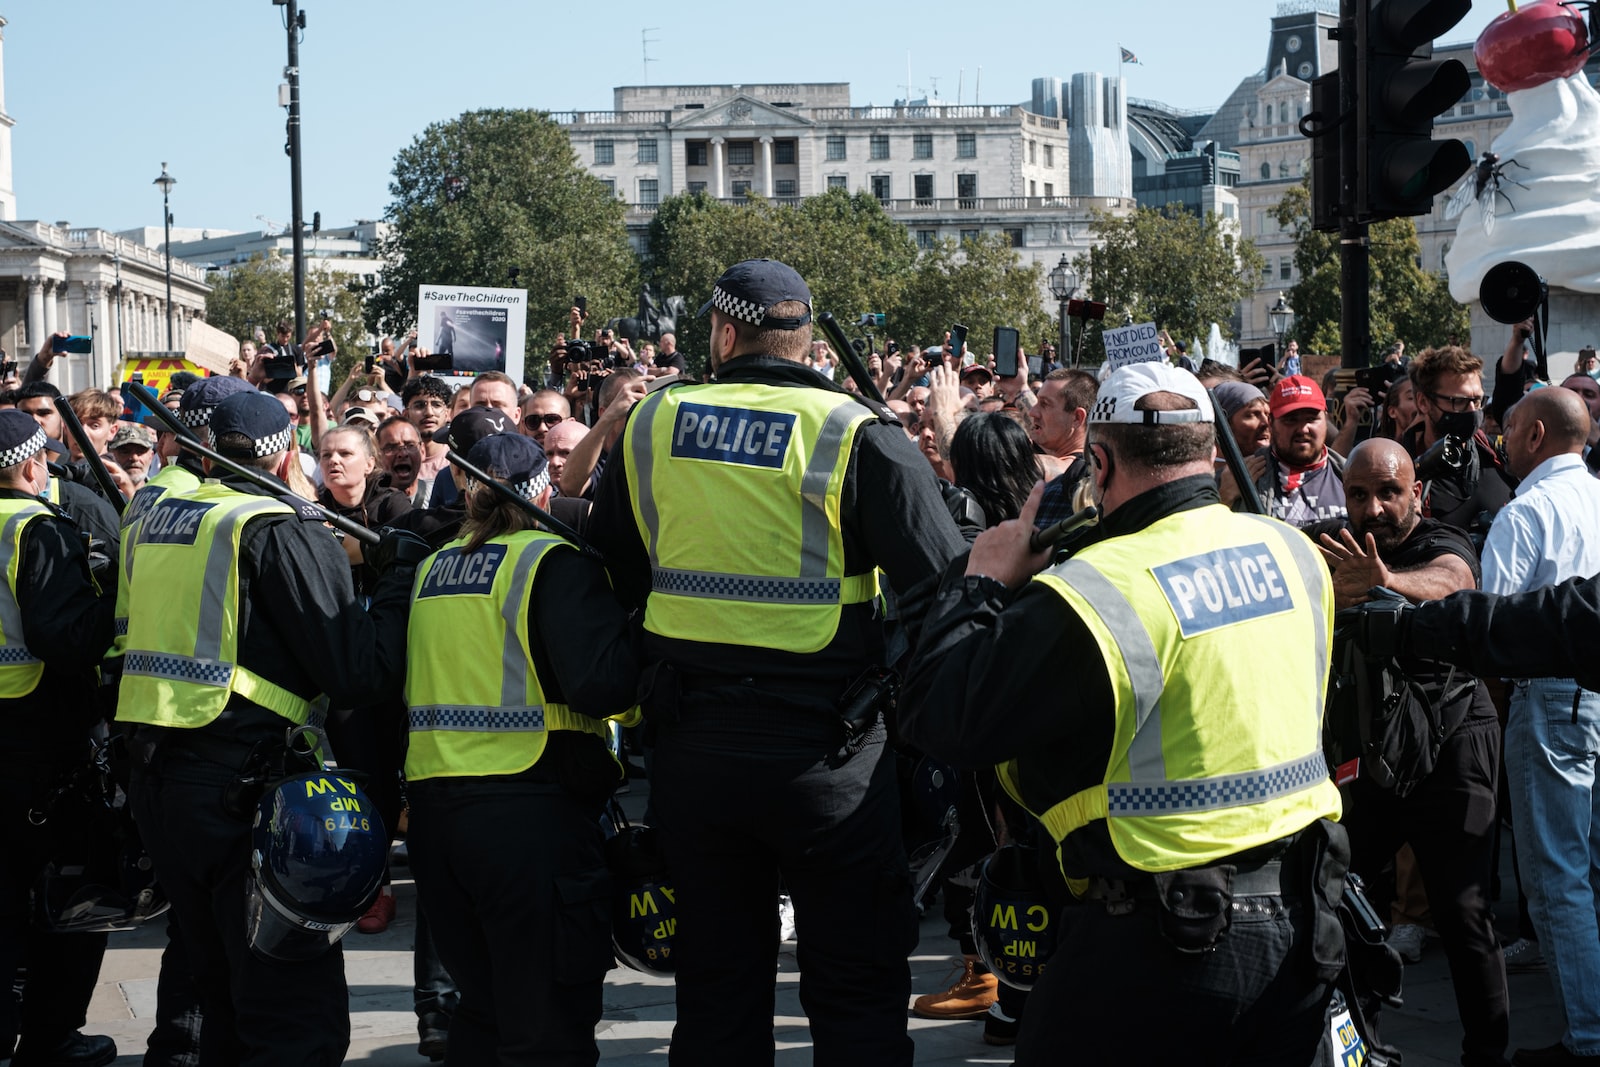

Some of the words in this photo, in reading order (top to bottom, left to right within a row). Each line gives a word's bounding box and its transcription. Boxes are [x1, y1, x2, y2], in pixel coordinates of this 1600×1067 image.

[424, 291, 520, 304] #SaveTheChildren
[1112, 330, 1129, 344] NOT
[1130, 326, 1156, 342] DIED
[1107, 348, 1132, 361] FROM
[1132, 343, 1160, 357] COVID
[676, 411, 787, 457] POLICE
[141, 505, 209, 535] POLICE
[423, 552, 499, 589] POLICE
[1168, 554, 1285, 620] POLICE
[330, 797, 361, 812] MP
[325, 816, 370, 831] 9779
[1003, 940, 1036, 957] MP
